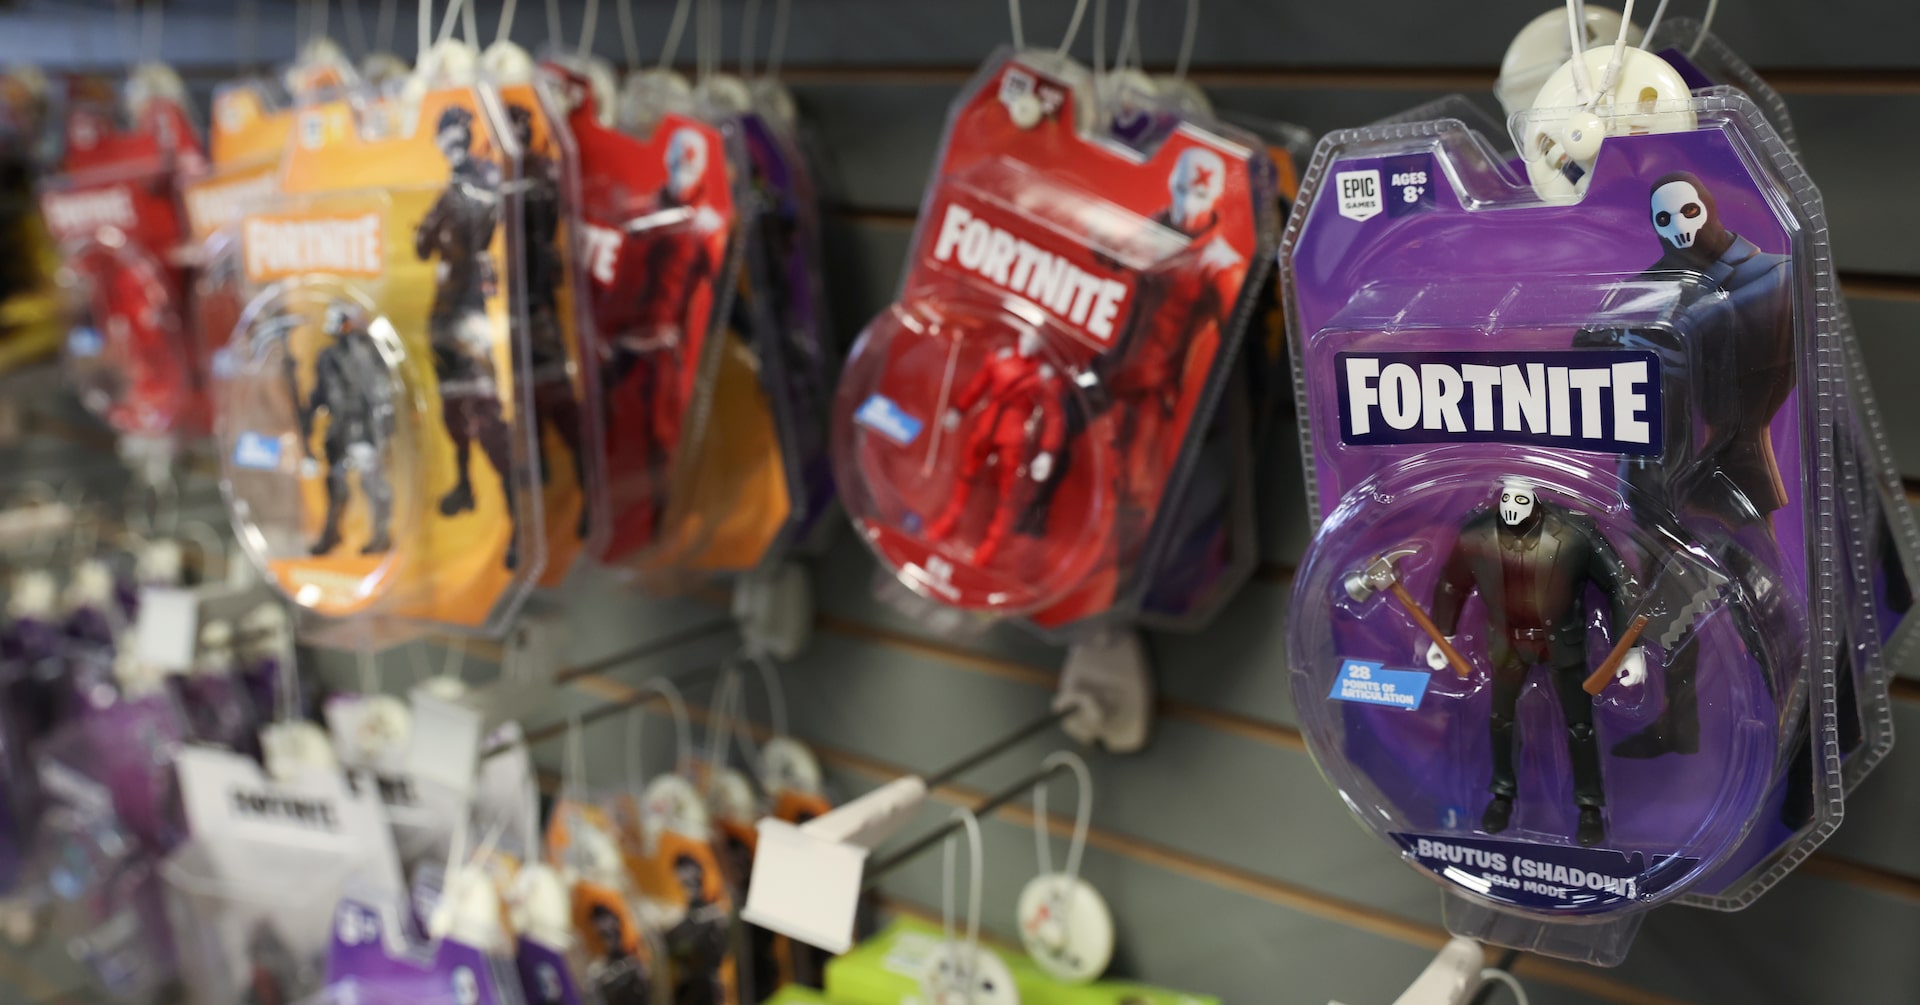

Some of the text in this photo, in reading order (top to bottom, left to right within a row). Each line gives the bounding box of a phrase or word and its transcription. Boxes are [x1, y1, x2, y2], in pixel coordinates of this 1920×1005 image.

[1343, 177, 1375, 199] EPIC
[1391, 171, 1428, 187] AGES
[1402, 185, 1425, 203] 8+
[1345, 201, 1376, 209] GAMES
[933, 203, 1127, 341] FORTNITE
[1345, 357, 1650, 444] FORTNITE
[1348, 665, 1371, 680] 28
[1342, 679, 1396, 693] POINTS OF
[1341, 688, 1414, 705] ARTICULATION
[1417, 838, 1508, 872] BRUTUS
[1481, 871, 1568, 900] SOLO MODE
